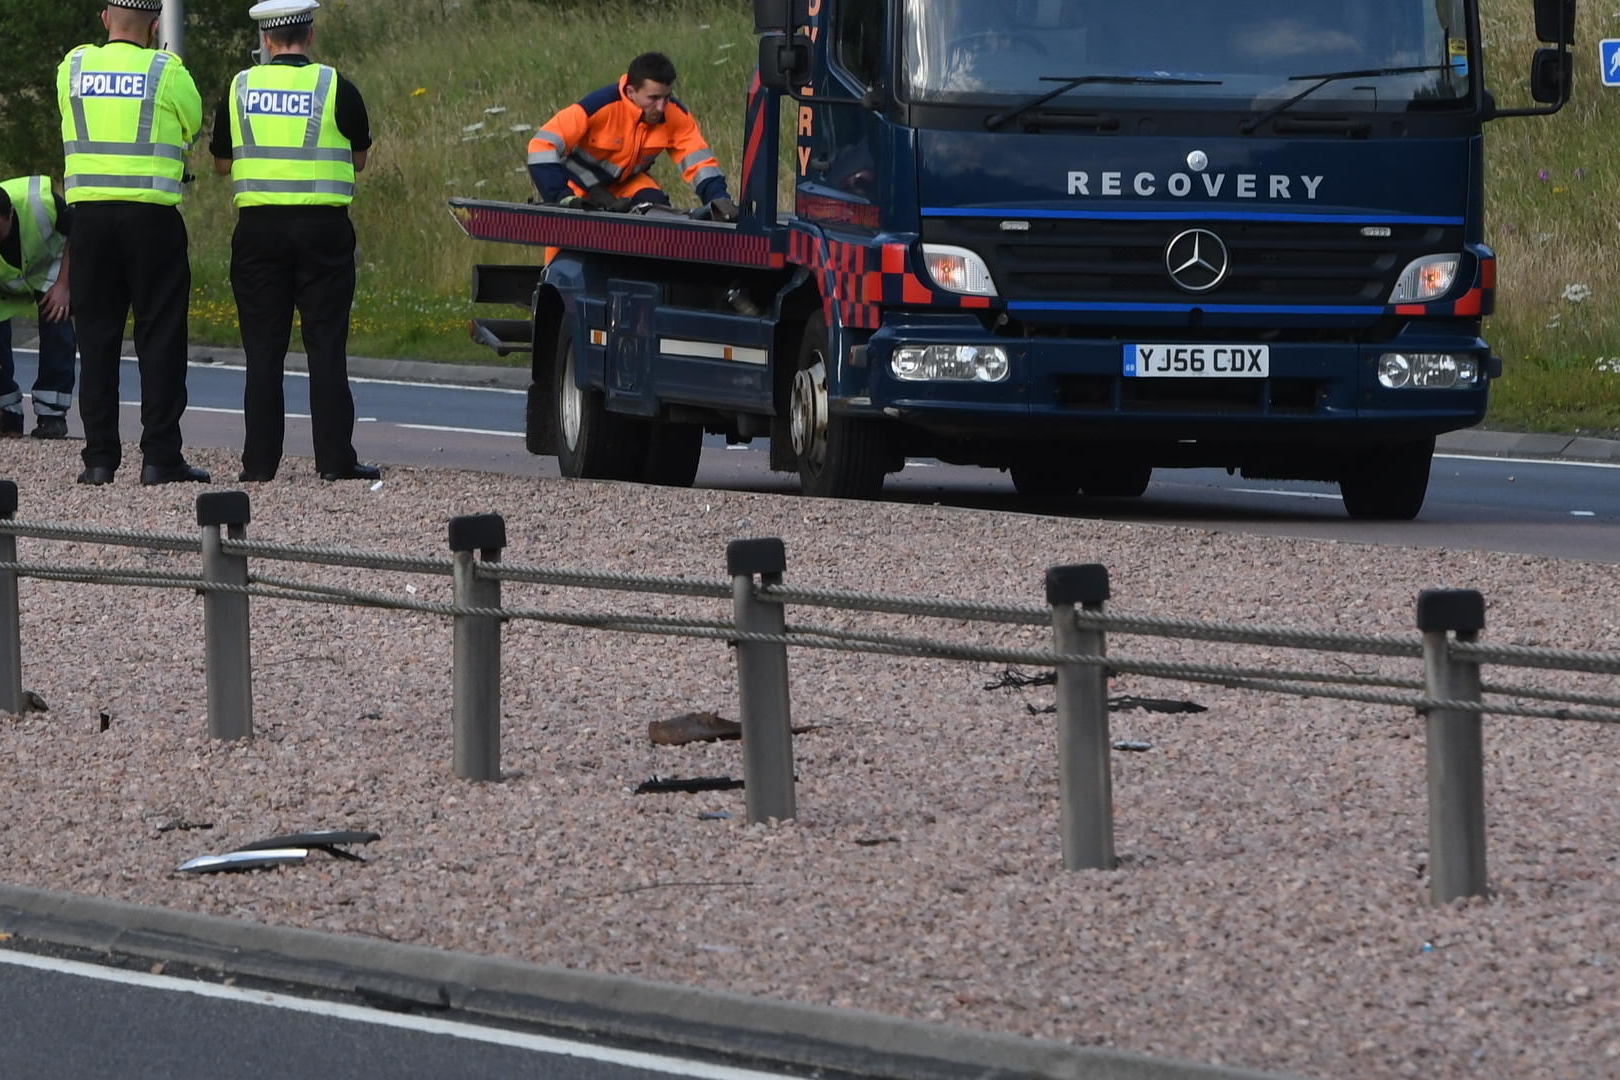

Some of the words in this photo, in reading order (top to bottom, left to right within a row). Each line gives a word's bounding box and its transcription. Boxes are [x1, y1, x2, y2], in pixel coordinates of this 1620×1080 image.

[82, 74, 144, 95] POLICE
[248, 91, 310, 114] POLICE
[1066, 170, 1325, 200] RECOVERY
[1139, 348, 1205, 372] YJ56
[1213, 348, 1263, 372] CDX
